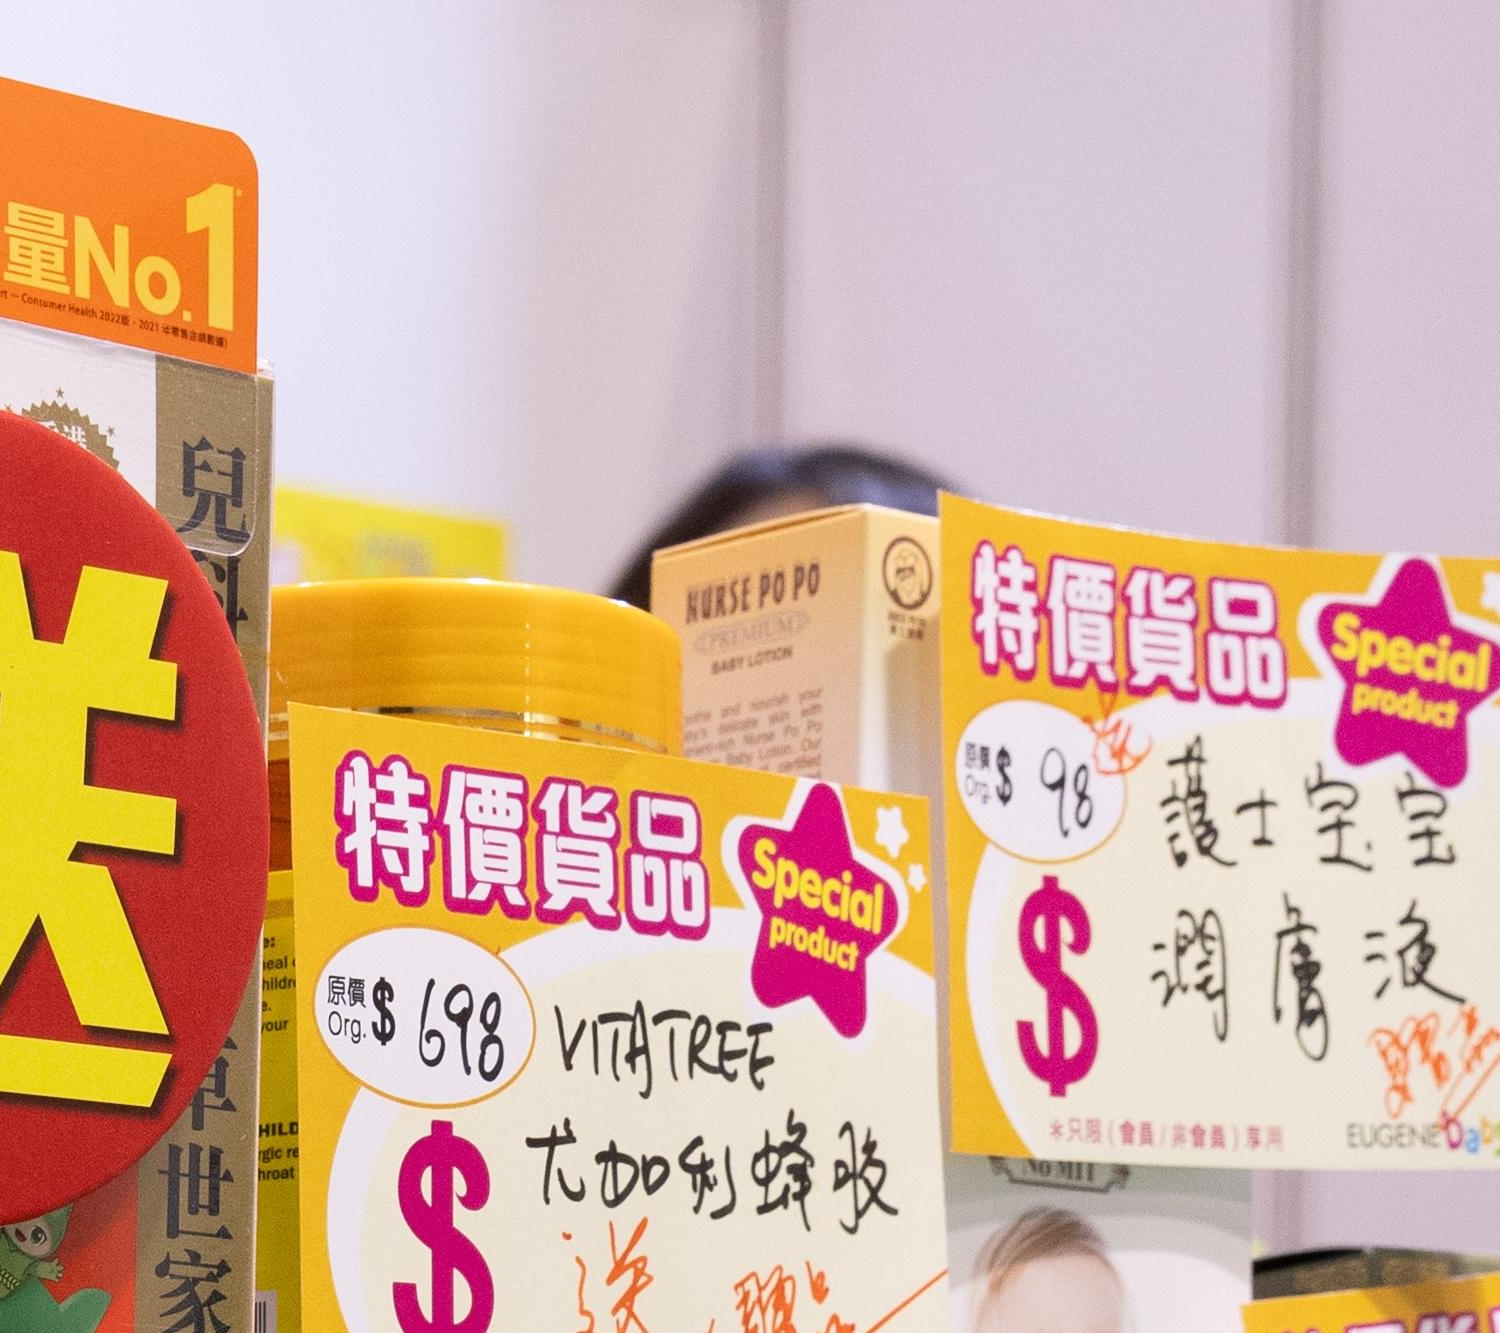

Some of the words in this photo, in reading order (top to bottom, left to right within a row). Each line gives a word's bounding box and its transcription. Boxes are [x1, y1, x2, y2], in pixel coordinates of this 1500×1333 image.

[794, 563, 820, 600] PO
[1331, 612, 1492, 695] Special
[1351, 683, 1461, 730] product
[1040, 746, 1096, 841] 98
[751, 836, 888, 934] Special
[769, 916, 861, 973] product
[327, 975, 367, 1009] 原價
